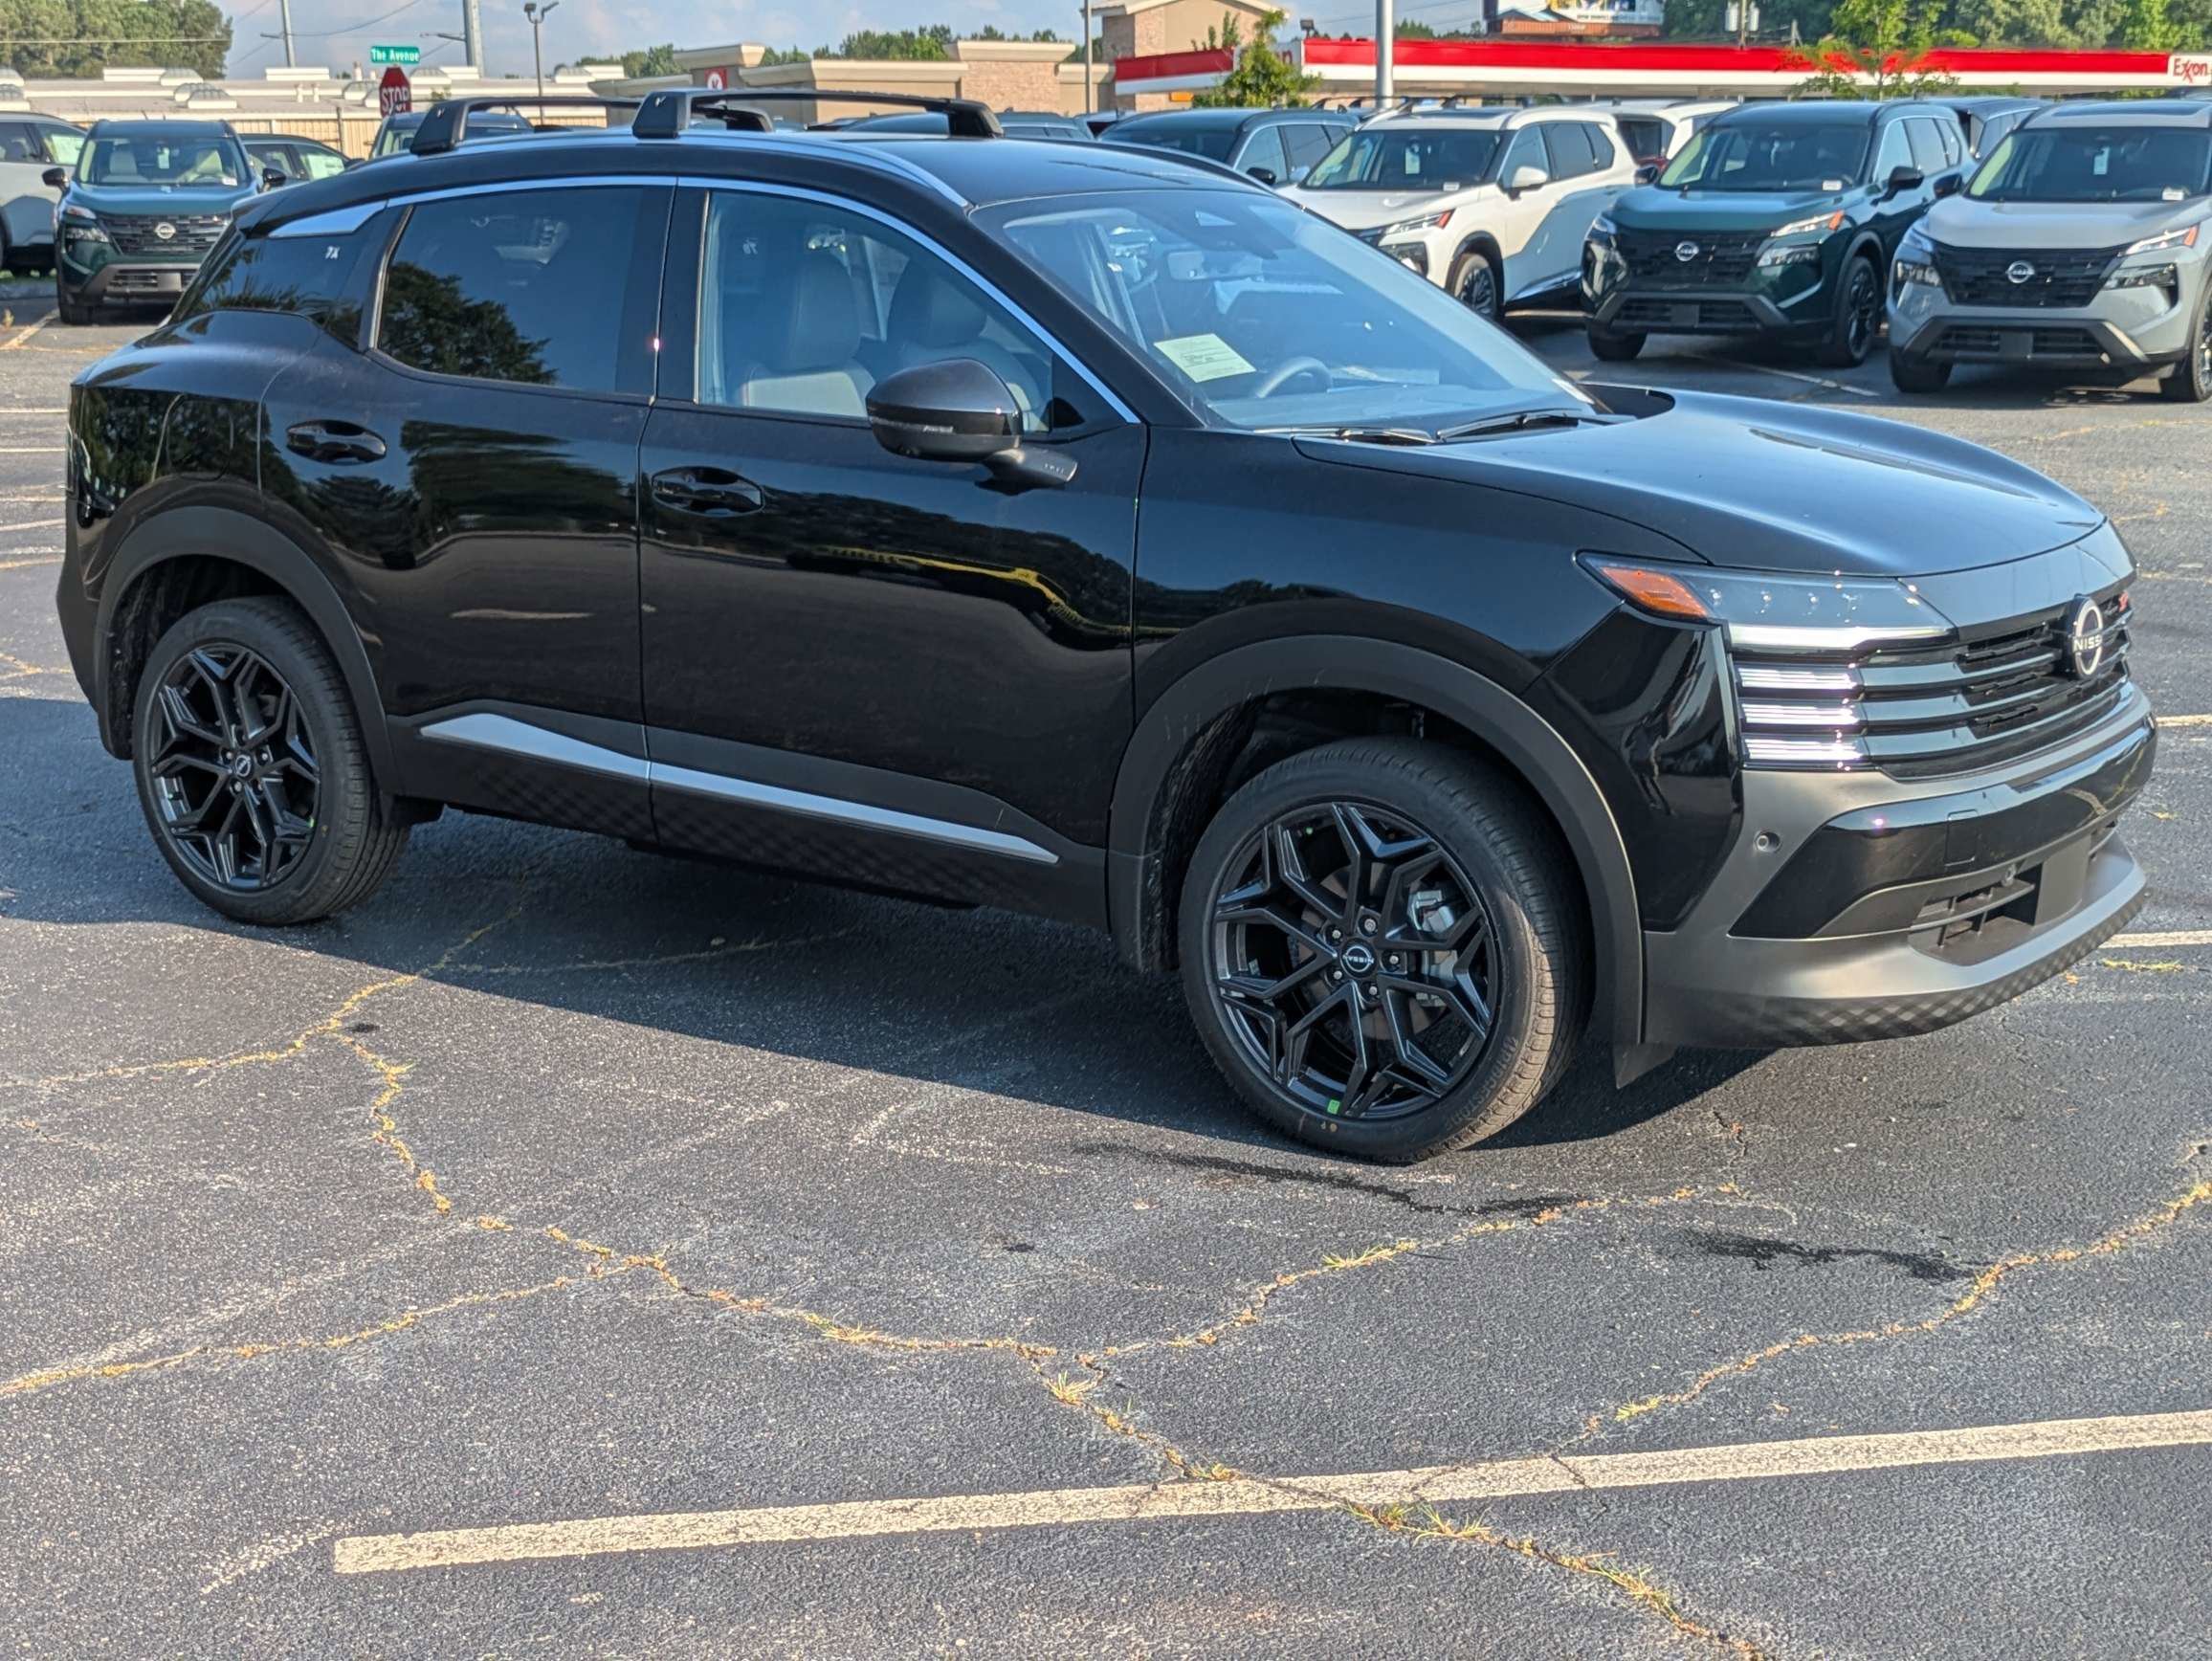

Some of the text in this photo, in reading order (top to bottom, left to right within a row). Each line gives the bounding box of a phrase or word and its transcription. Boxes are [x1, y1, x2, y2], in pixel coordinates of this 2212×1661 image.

[371, 48, 419, 62] The Avenue
[2173, 57, 2208, 84] Exxon
[382, 86, 409, 114] STOP
